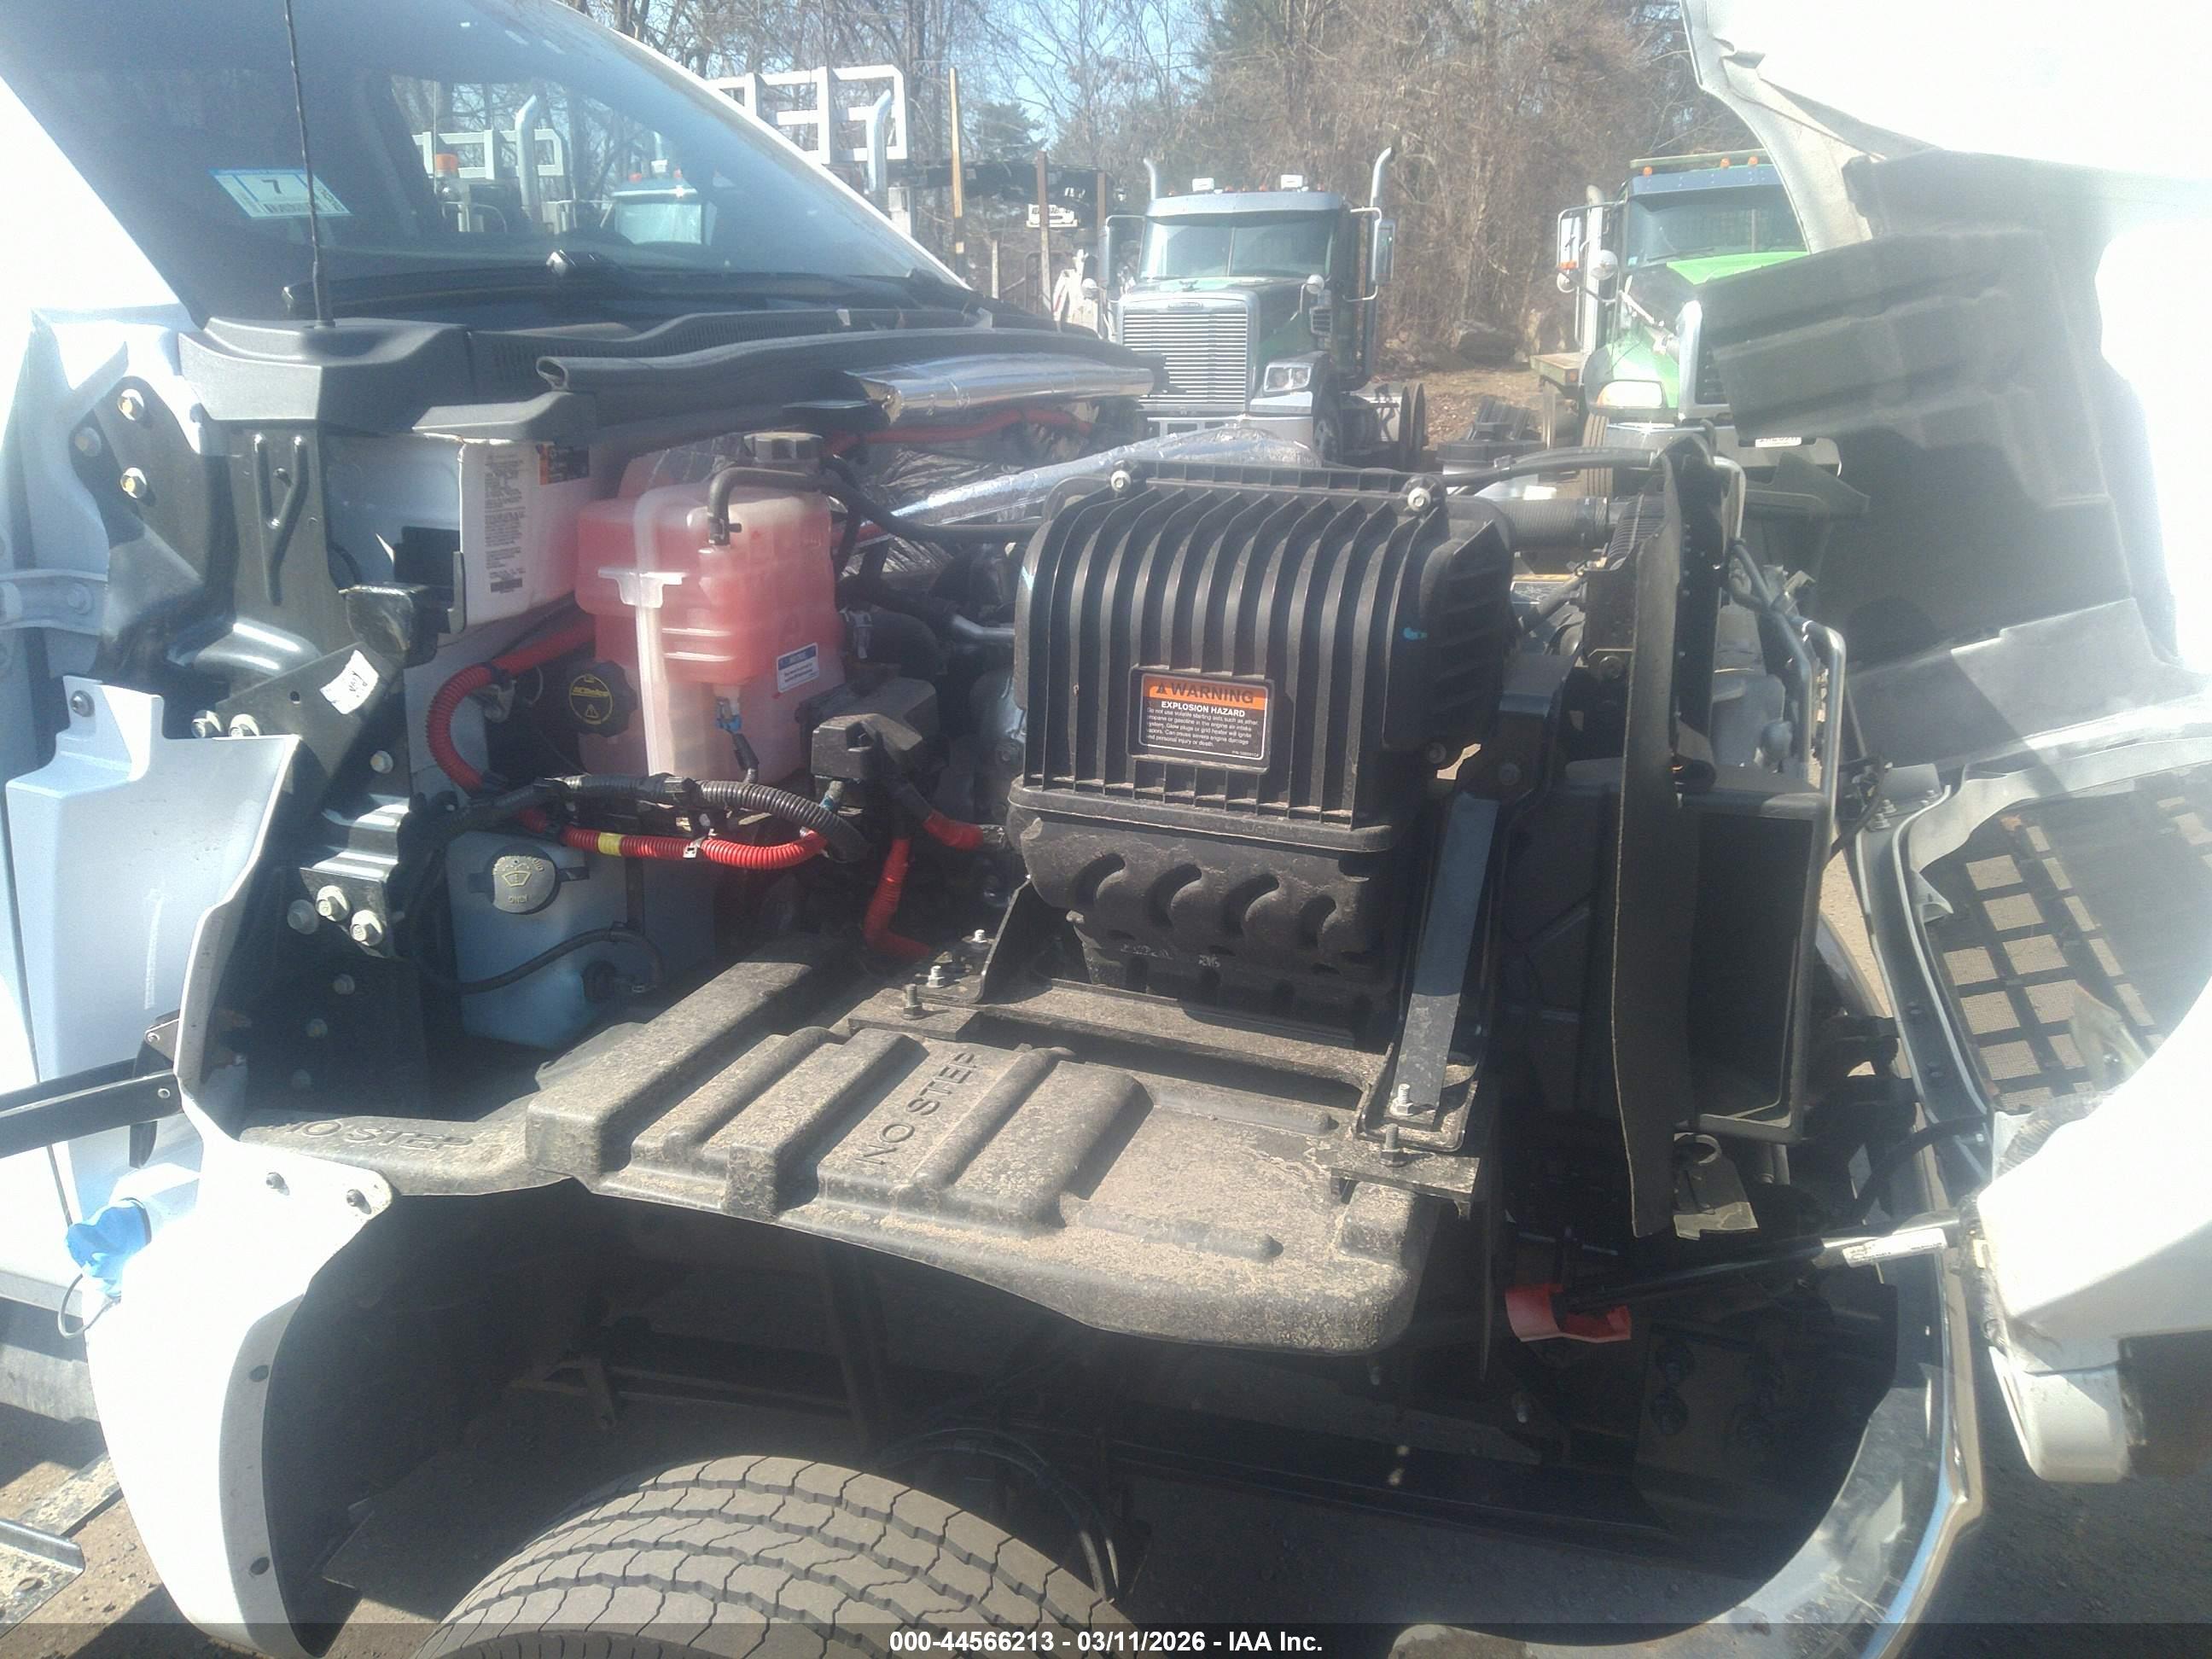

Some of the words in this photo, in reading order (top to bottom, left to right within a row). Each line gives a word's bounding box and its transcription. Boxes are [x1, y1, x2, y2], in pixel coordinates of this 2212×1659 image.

[261, 178, 282, 195] 7
[1171, 683, 1254, 704] WARNING
[1161, 701, 1209, 713] EXPLOSION
[1210, 707, 1245, 718] HAZARD
[853, 1122, 916, 1166] NO
[905, 1052, 978, 1116] STEP
[267, 1119, 341, 1137] O
[343, 1126, 474, 1152] STEP
